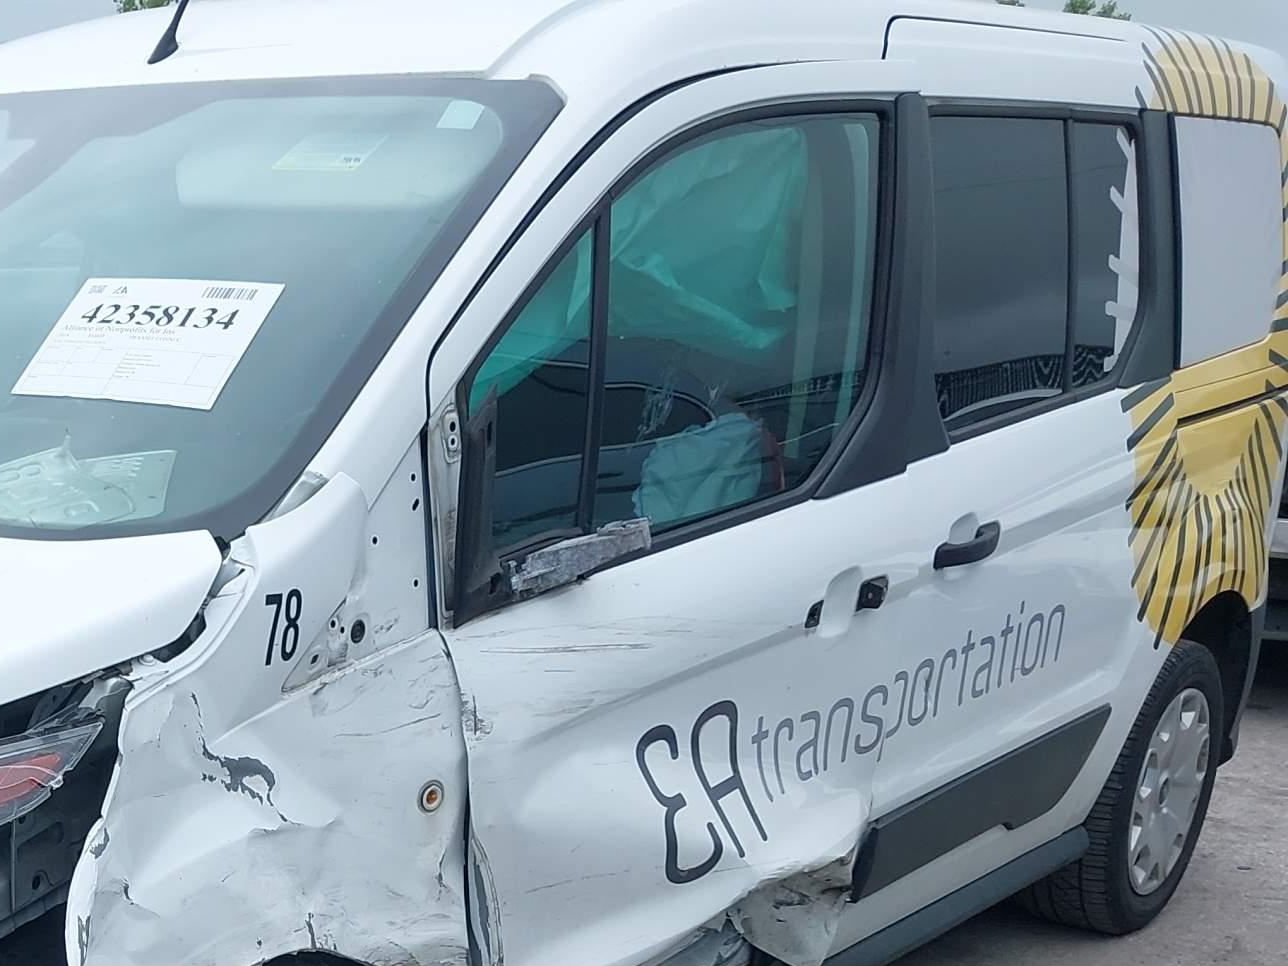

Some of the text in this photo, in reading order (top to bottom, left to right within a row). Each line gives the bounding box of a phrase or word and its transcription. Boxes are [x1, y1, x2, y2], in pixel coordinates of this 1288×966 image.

[81, 303, 240, 330] 42358134
[265, 588, 303, 666] 78
[751, 601, 1066, 802] transportation
